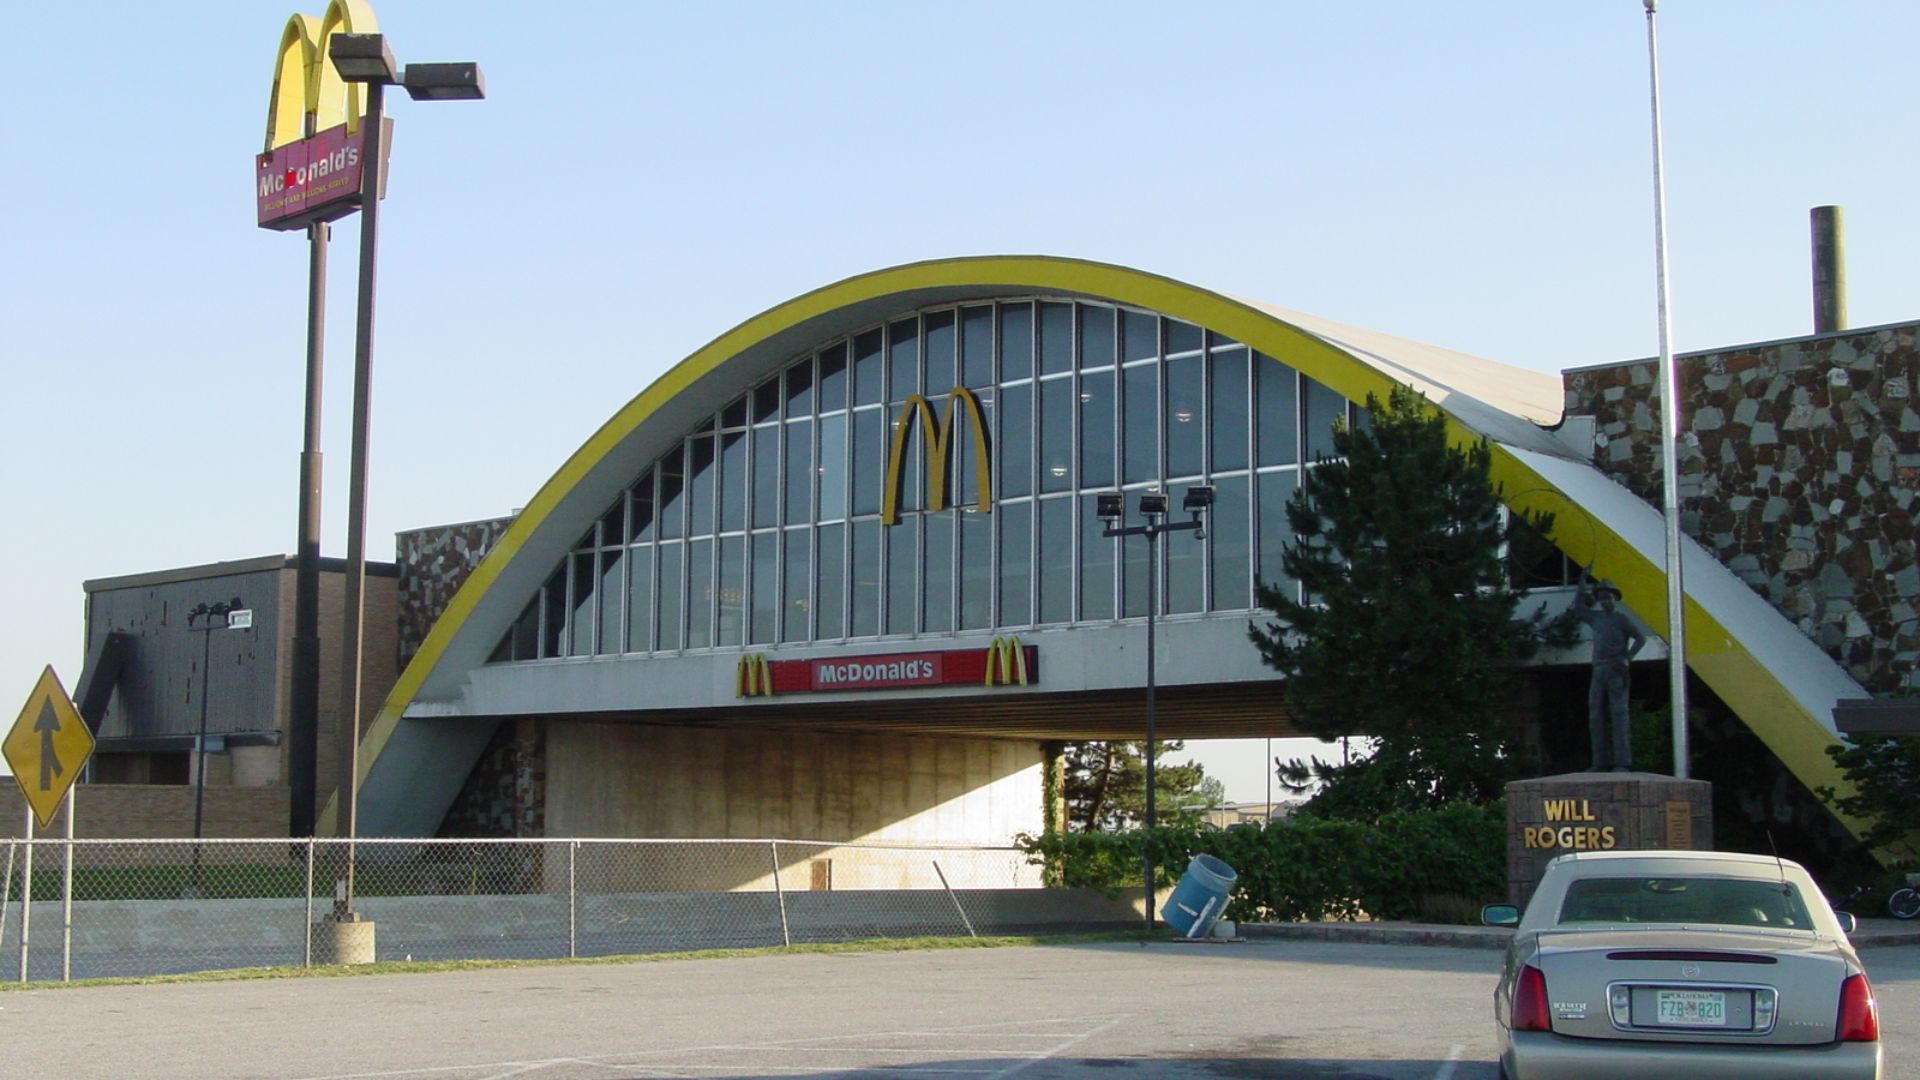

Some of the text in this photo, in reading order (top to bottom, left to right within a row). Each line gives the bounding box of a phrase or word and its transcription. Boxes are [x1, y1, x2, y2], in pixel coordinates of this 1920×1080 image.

[819, 659, 934, 683] McDonald's
[1543, 799, 1596, 822] WILL
[1524, 826, 1616, 849] ROGERS
